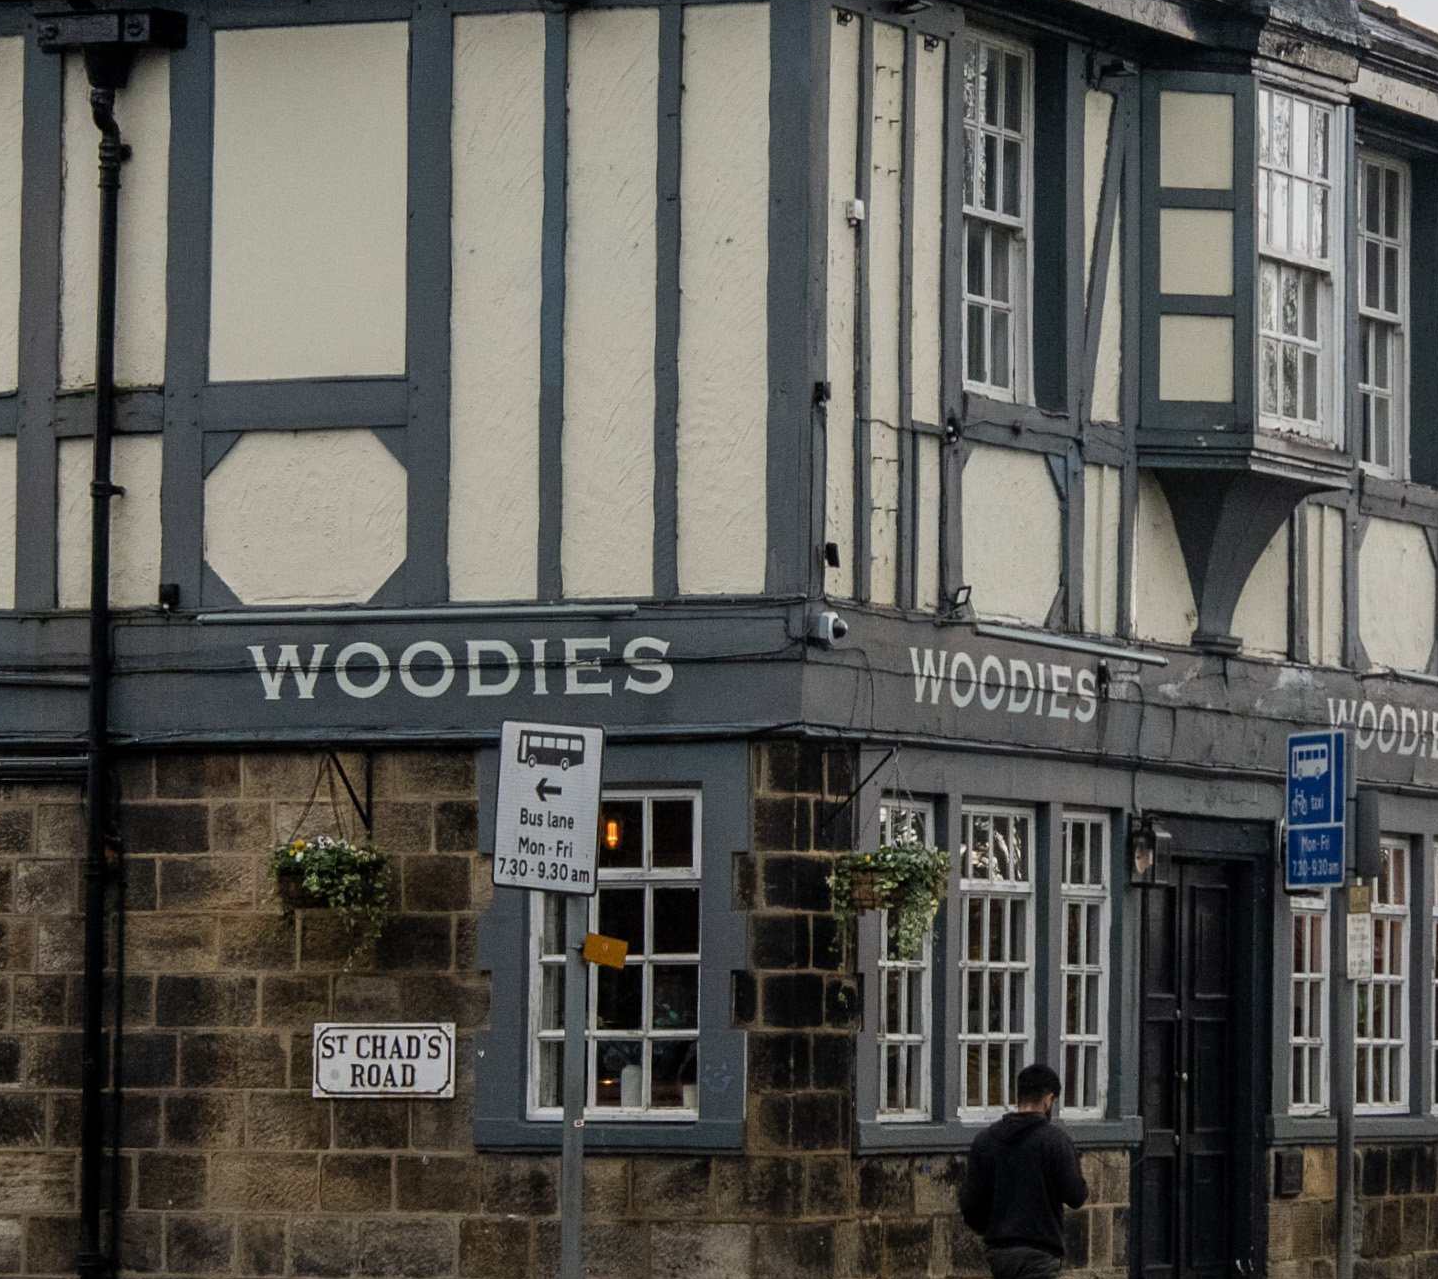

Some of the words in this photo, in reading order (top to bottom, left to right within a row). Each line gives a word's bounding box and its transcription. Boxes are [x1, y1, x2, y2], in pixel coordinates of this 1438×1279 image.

[247, 635, 674, 700] WOODIES
[909, 647, 1098, 723] WOODIES
[1311, 793, 1325, 810] taxi
[519, 807, 543, 827] Bus
[547, 810, 574, 829] lane
[518, 836, 545, 856] Mon
[556, 840, 573, 858] Fri
[498, 857, 528, 877] 7.30
[538, 860, 568, 880] 9.30
[571, 868, 590, 883] am
[356, 1033, 442, 1059] CHAD'S
[350, 1063, 415, 1088] ROAD
